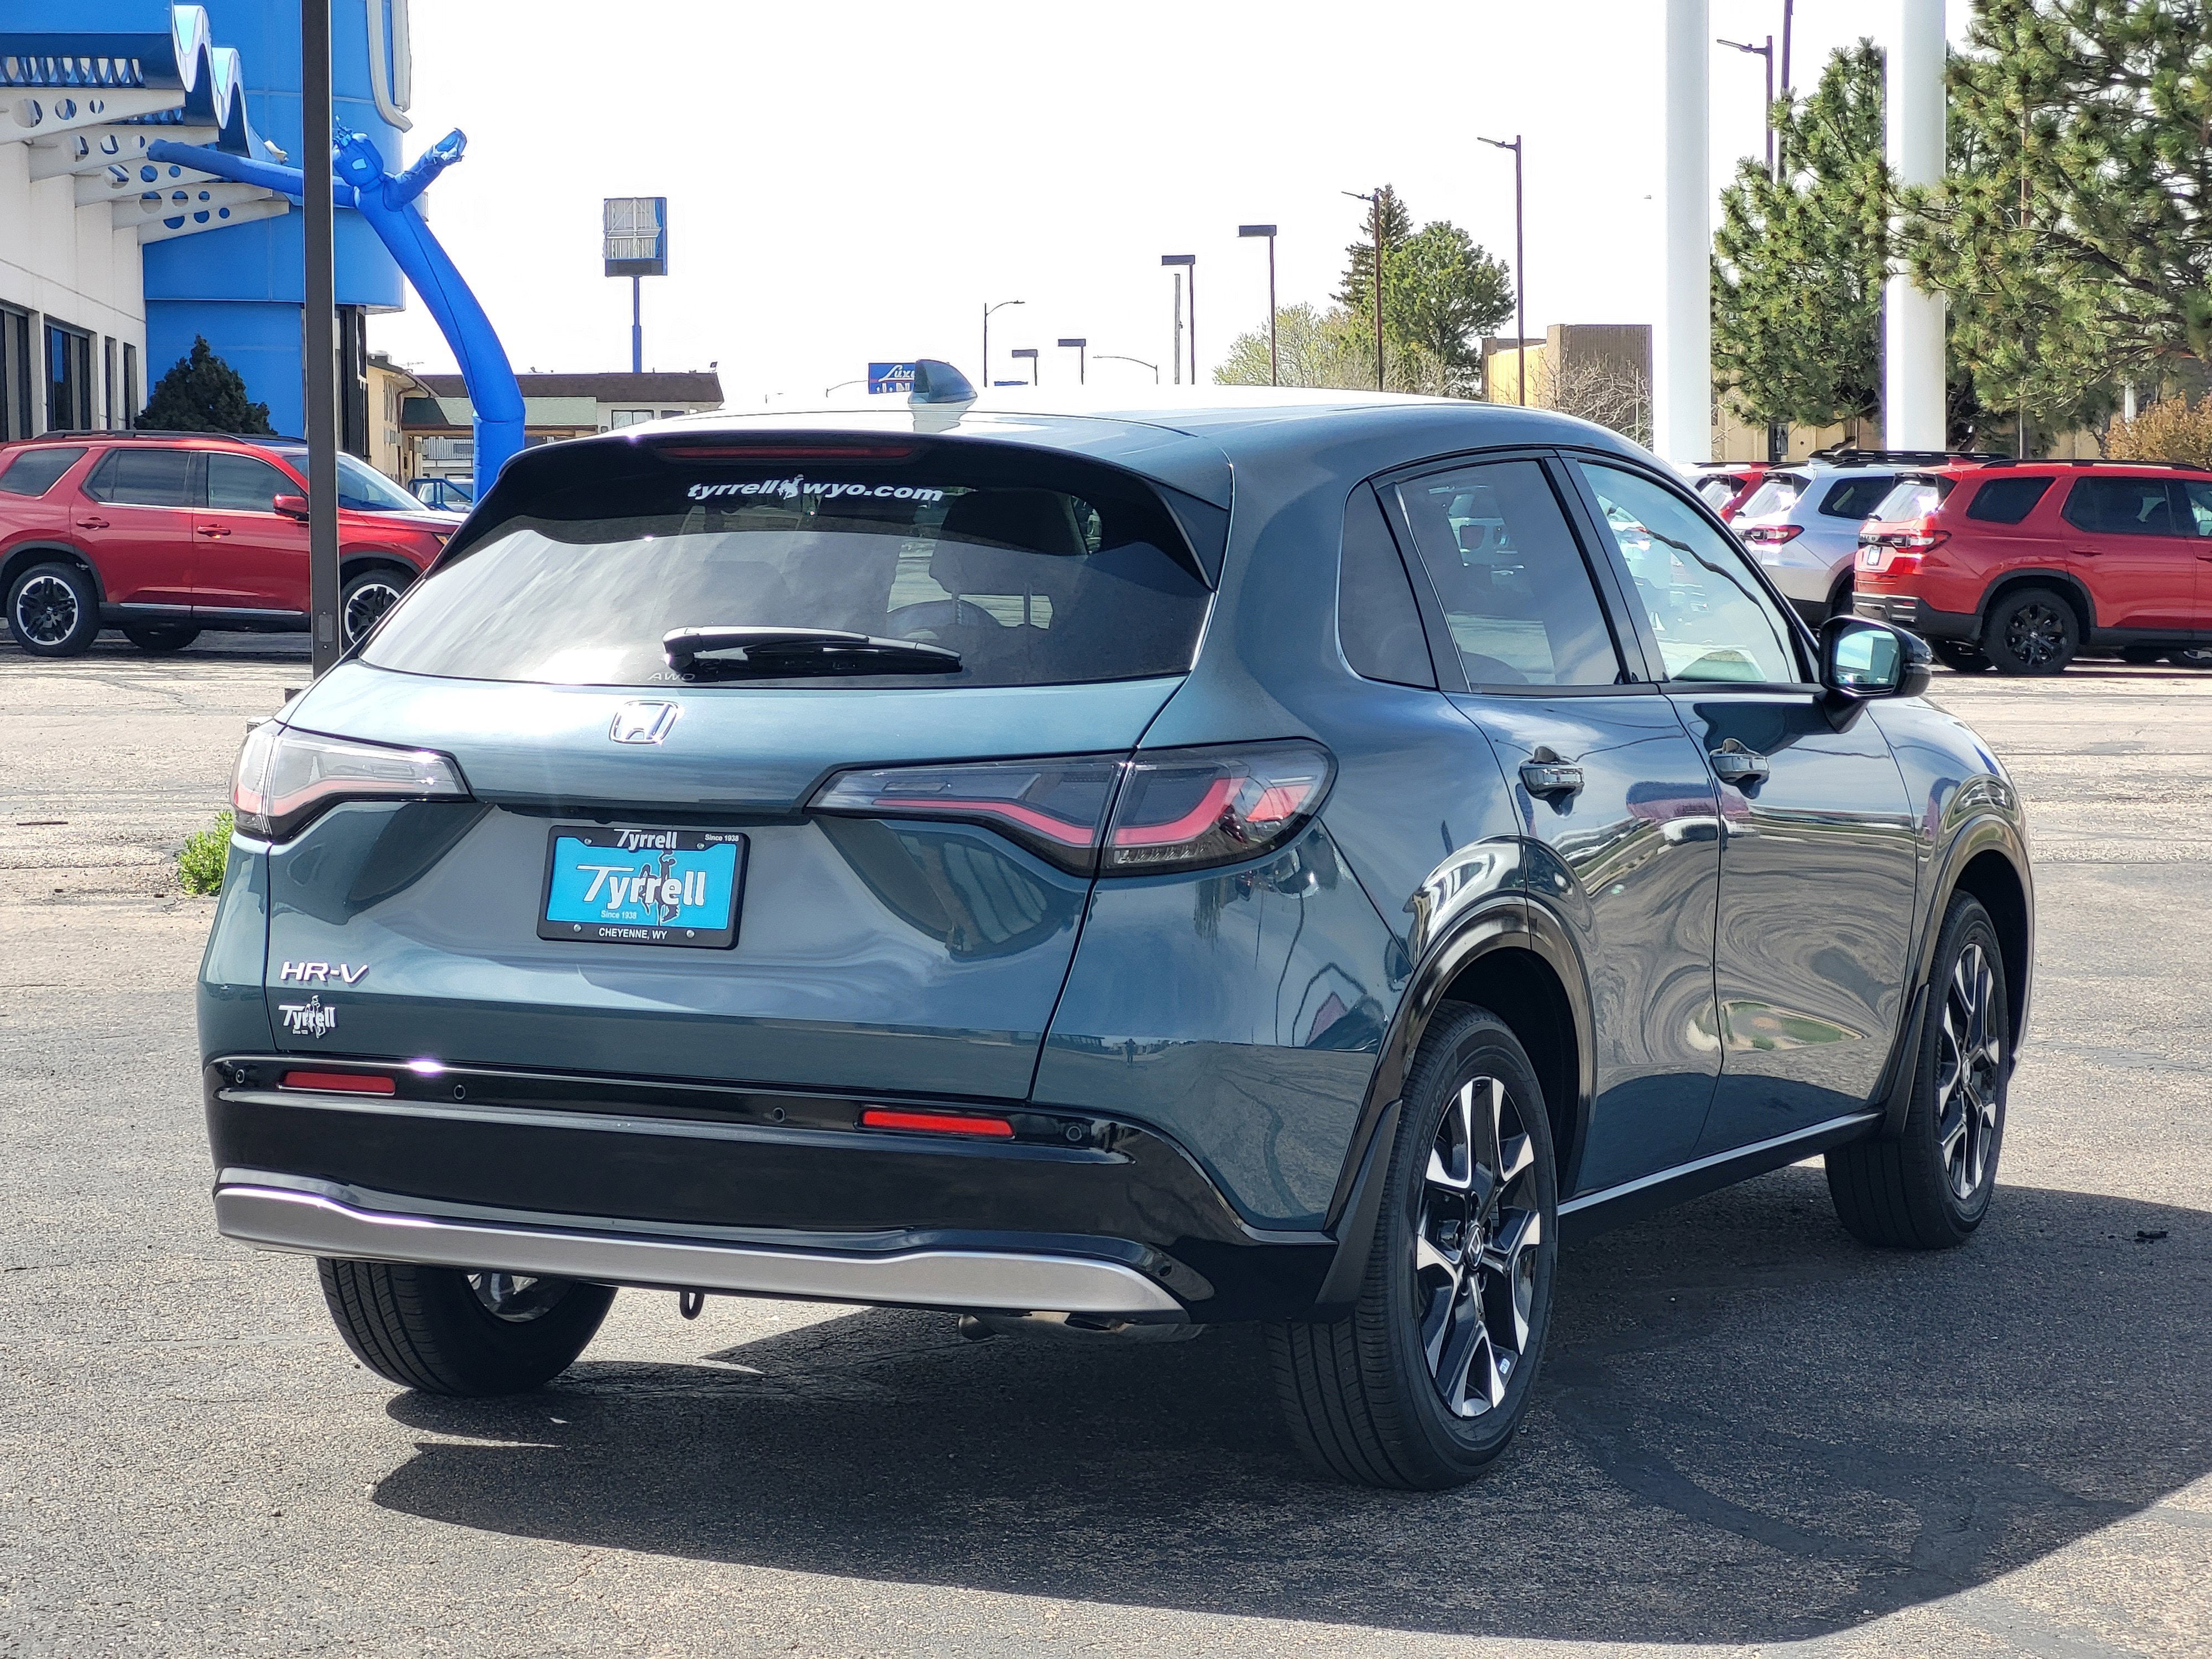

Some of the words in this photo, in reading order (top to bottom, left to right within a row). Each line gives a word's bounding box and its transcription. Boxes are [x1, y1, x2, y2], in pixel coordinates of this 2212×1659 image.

[646, 672, 695, 681] AWD
[613, 828, 677, 851] Tyrrell
[705, 833, 723, 842] Since
[576, 864, 706, 910] Tyrrell
[601, 910, 620, 919] Since
[621, 911, 637, 920] 1938
[598, 927, 651, 940] CHEYENNE,
[650, 930, 668, 940] WY
[280, 961, 369, 984] HR-V
[278, 1005, 336, 1030] Tyrrell
